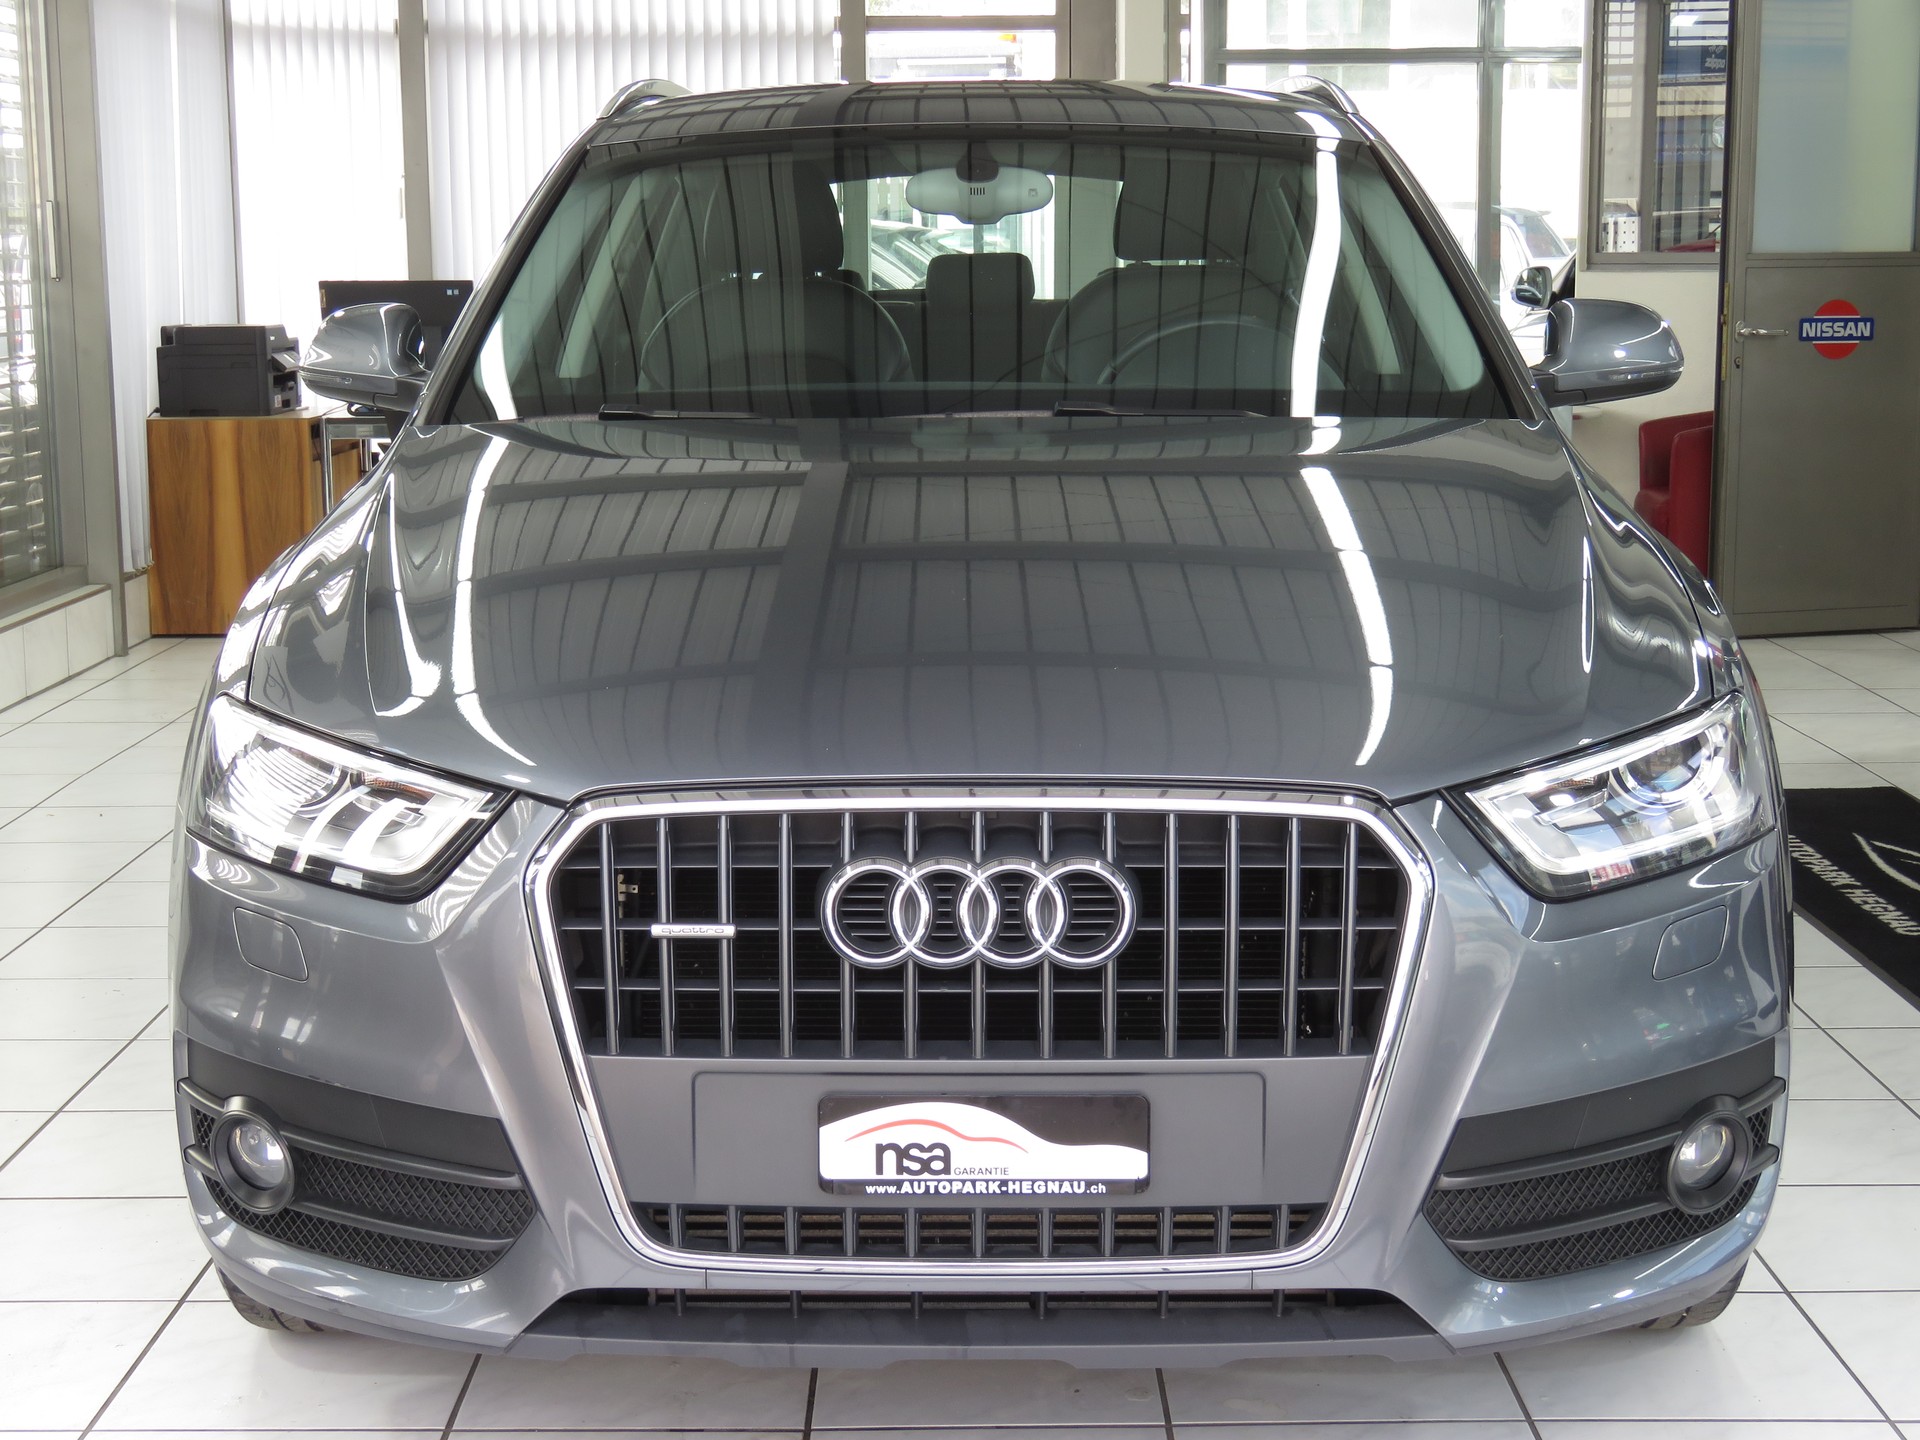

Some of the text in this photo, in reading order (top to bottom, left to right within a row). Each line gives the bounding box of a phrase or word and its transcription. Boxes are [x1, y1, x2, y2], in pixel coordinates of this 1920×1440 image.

[1802, 321, 1871, 337] NISSAN
[1788, 834, 1920, 936] UTOPARK HEGNAU
[661, 927, 725, 935] quattro
[875, 1142, 1010, 1176] nsa GARANTIE
[865, 1180, 1107, 1195] www.AUTOPARK-HEGNAU.ch
